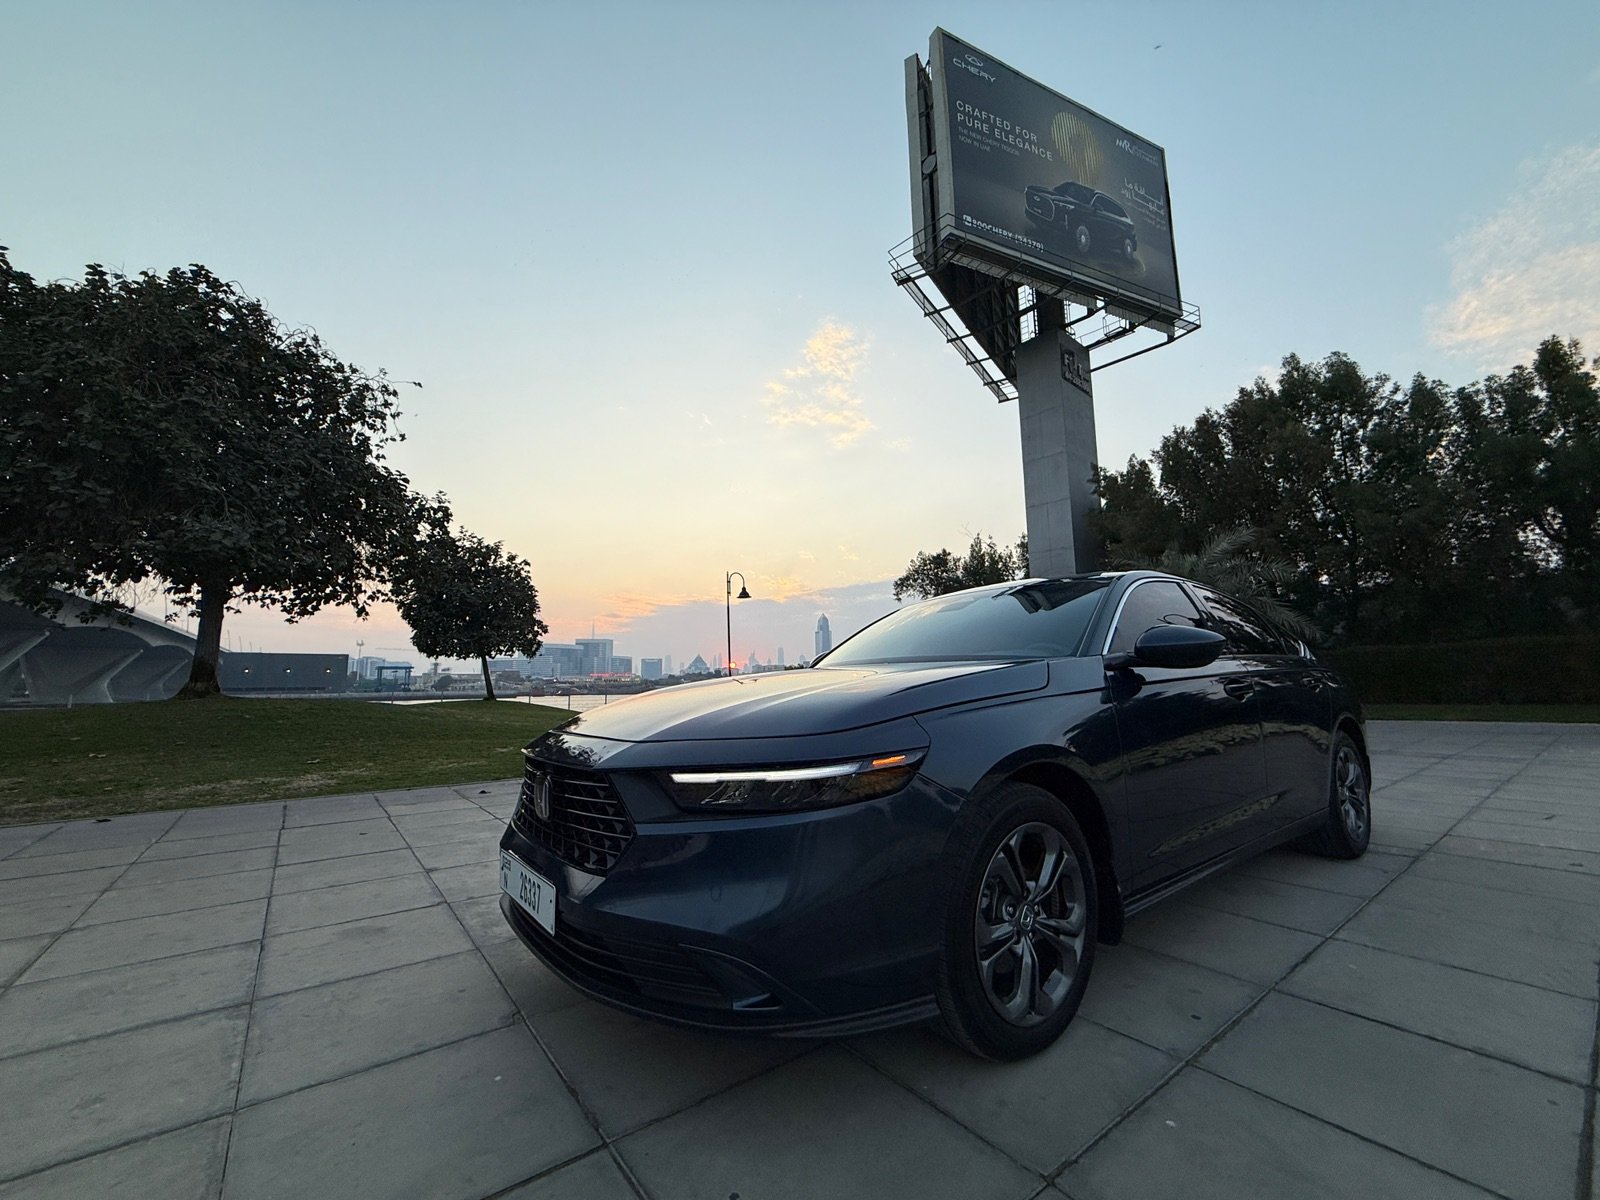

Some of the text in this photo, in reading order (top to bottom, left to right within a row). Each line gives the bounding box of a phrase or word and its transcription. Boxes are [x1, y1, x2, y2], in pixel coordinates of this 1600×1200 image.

[953, 58, 996, 82] CHERY
[956, 100, 1038, 142] CRAFTED FOR
[957, 113, 1053, 161] PURE ELEGANCE
[520, 871, 541, 914] 26337
